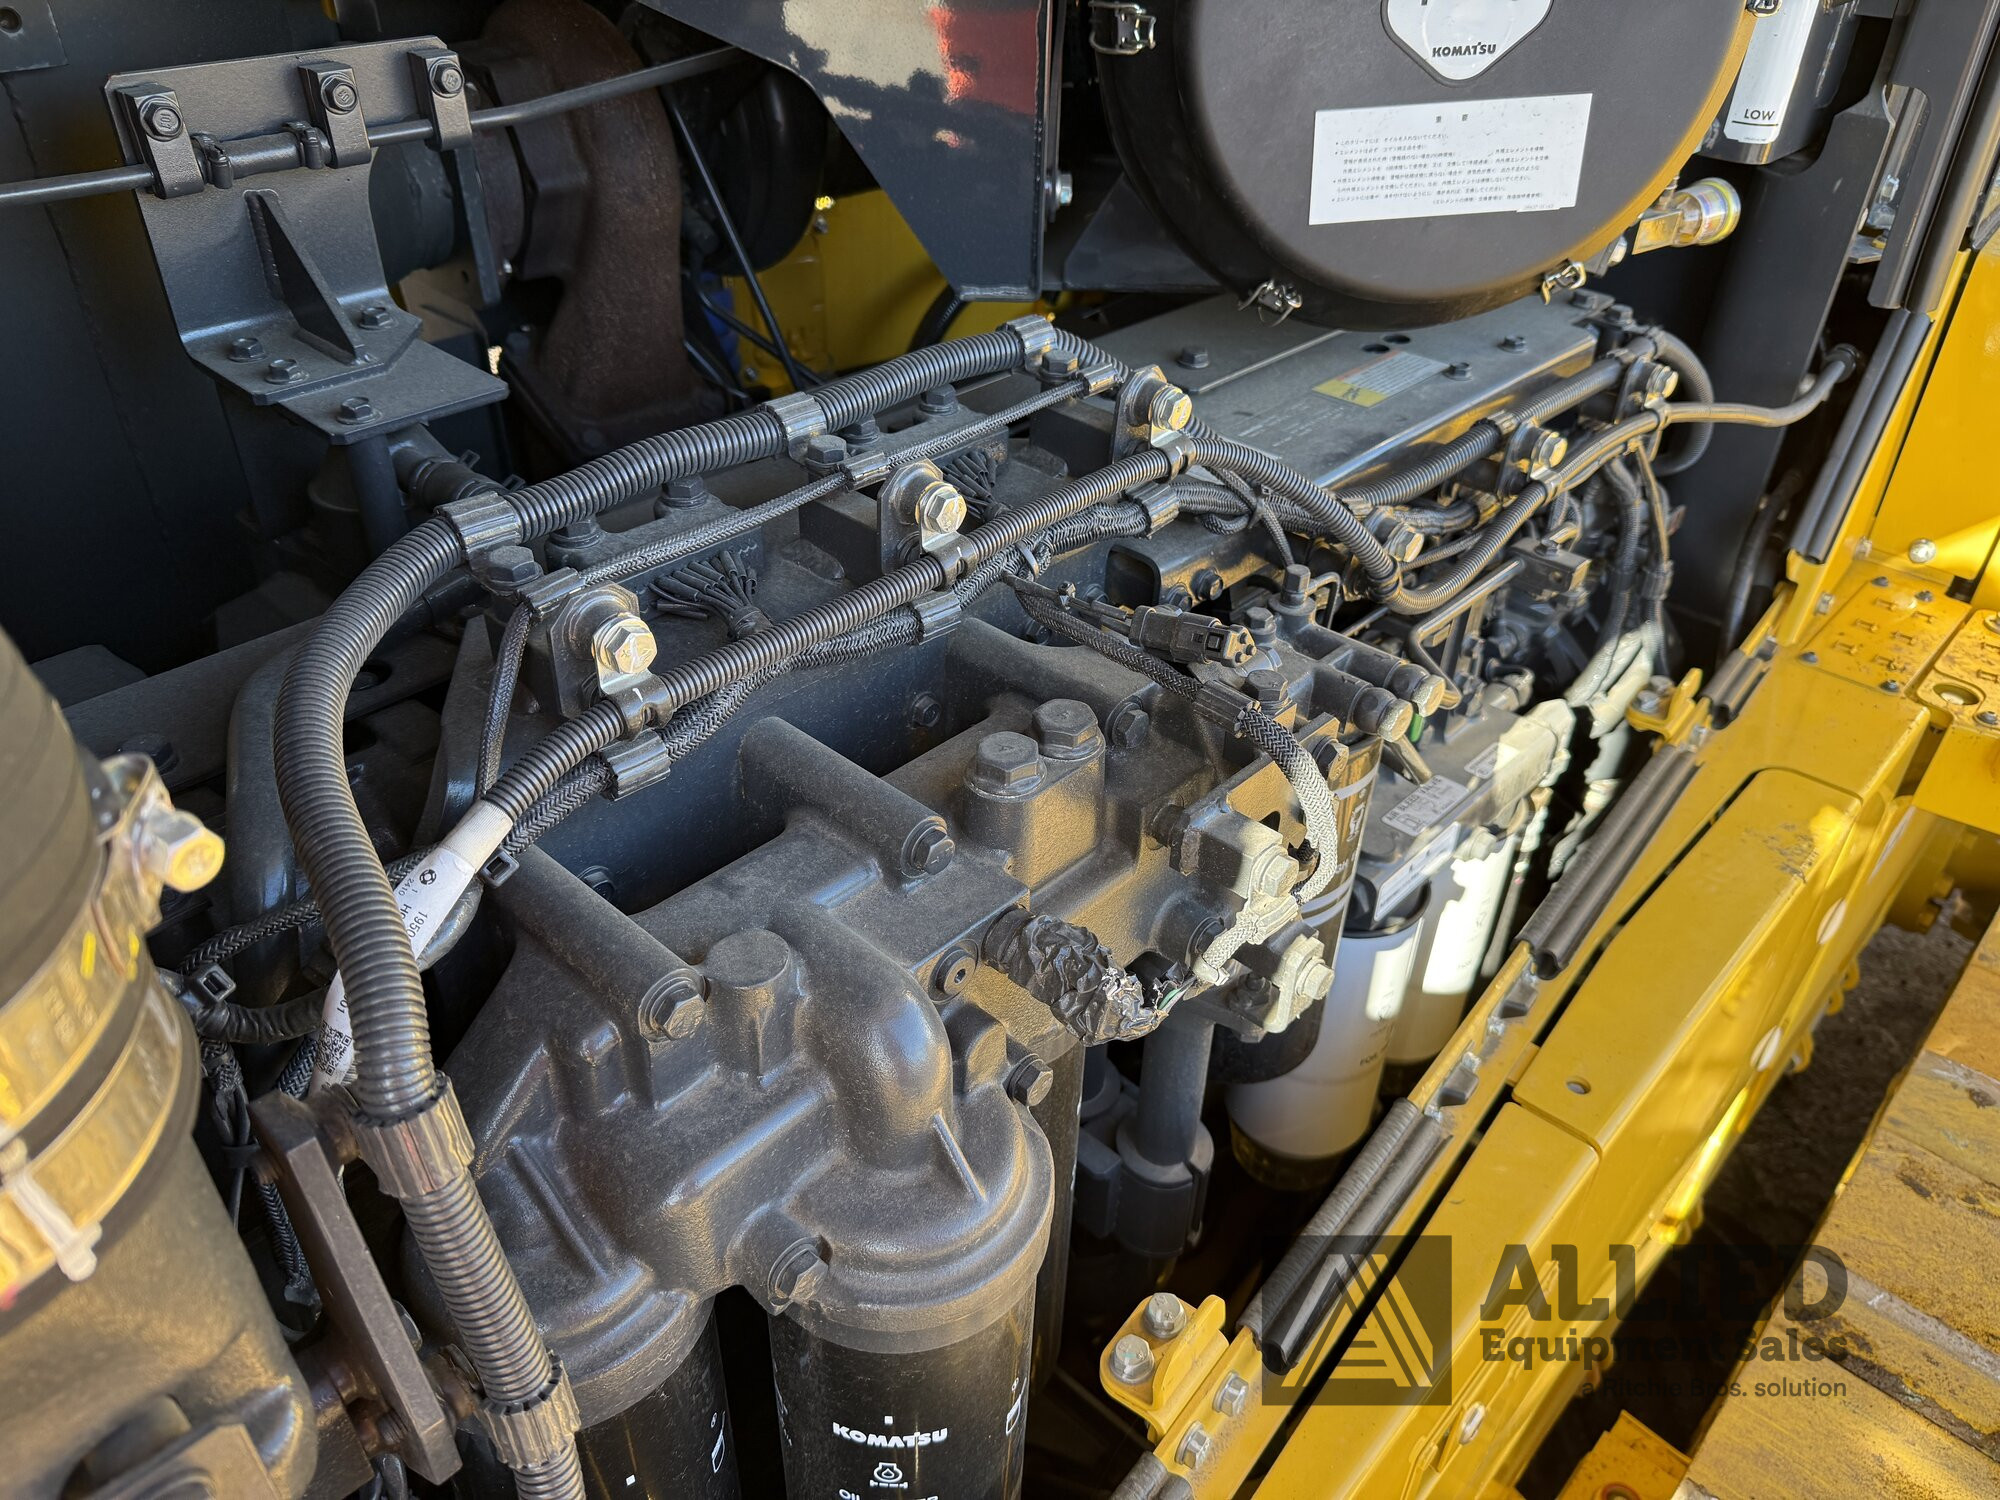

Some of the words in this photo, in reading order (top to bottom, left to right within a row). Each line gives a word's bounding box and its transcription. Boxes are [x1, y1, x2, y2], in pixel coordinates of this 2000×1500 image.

[1432, 42, 1497, 58] KOMATSU
[1743, 109, 1775, 120] LOW
[833, 1421, 948, 1448] KOMATSU
